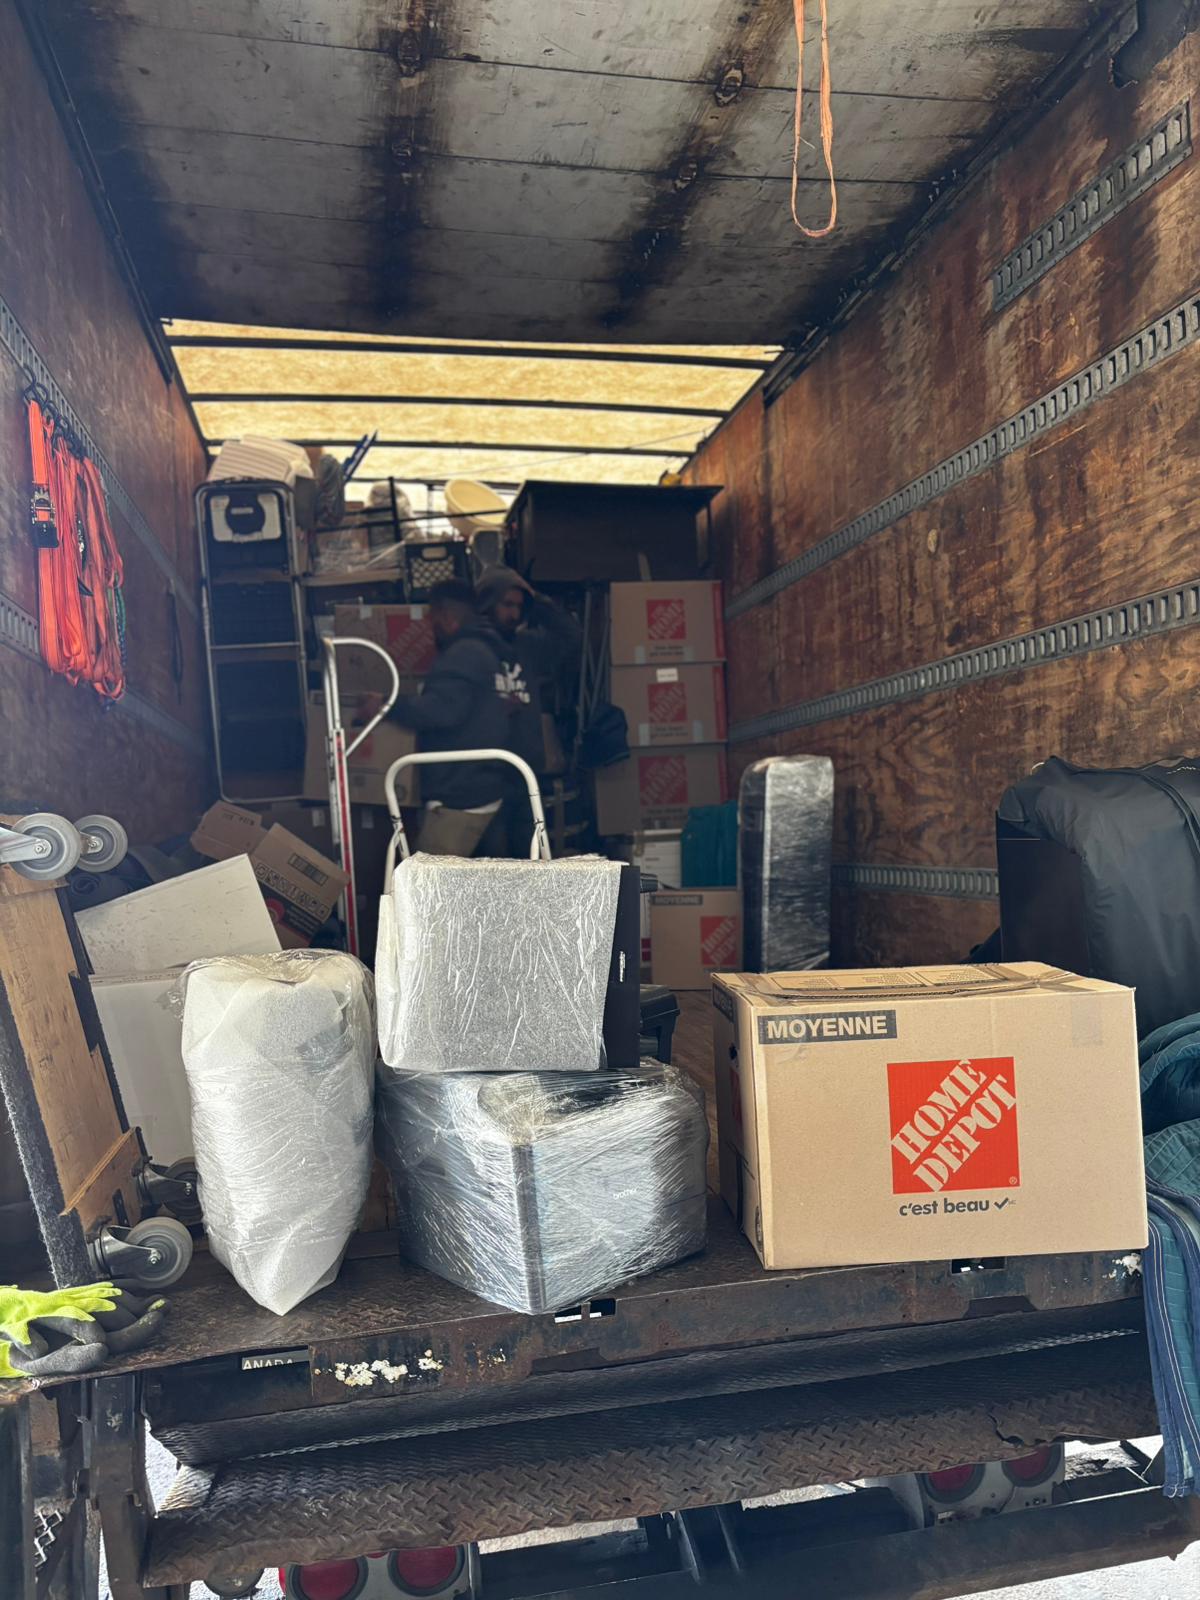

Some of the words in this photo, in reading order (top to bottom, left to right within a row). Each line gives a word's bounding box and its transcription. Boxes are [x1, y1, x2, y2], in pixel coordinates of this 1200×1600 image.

[767, 1015, 888, 1039] MOYENNE
[890, 1059, 988, 1164] HOME
[912, 1074, 1017, 1192] DEPOT
[899, 1200, 938, 1216] c'est
[943, 1198, 990, 1213] beau
